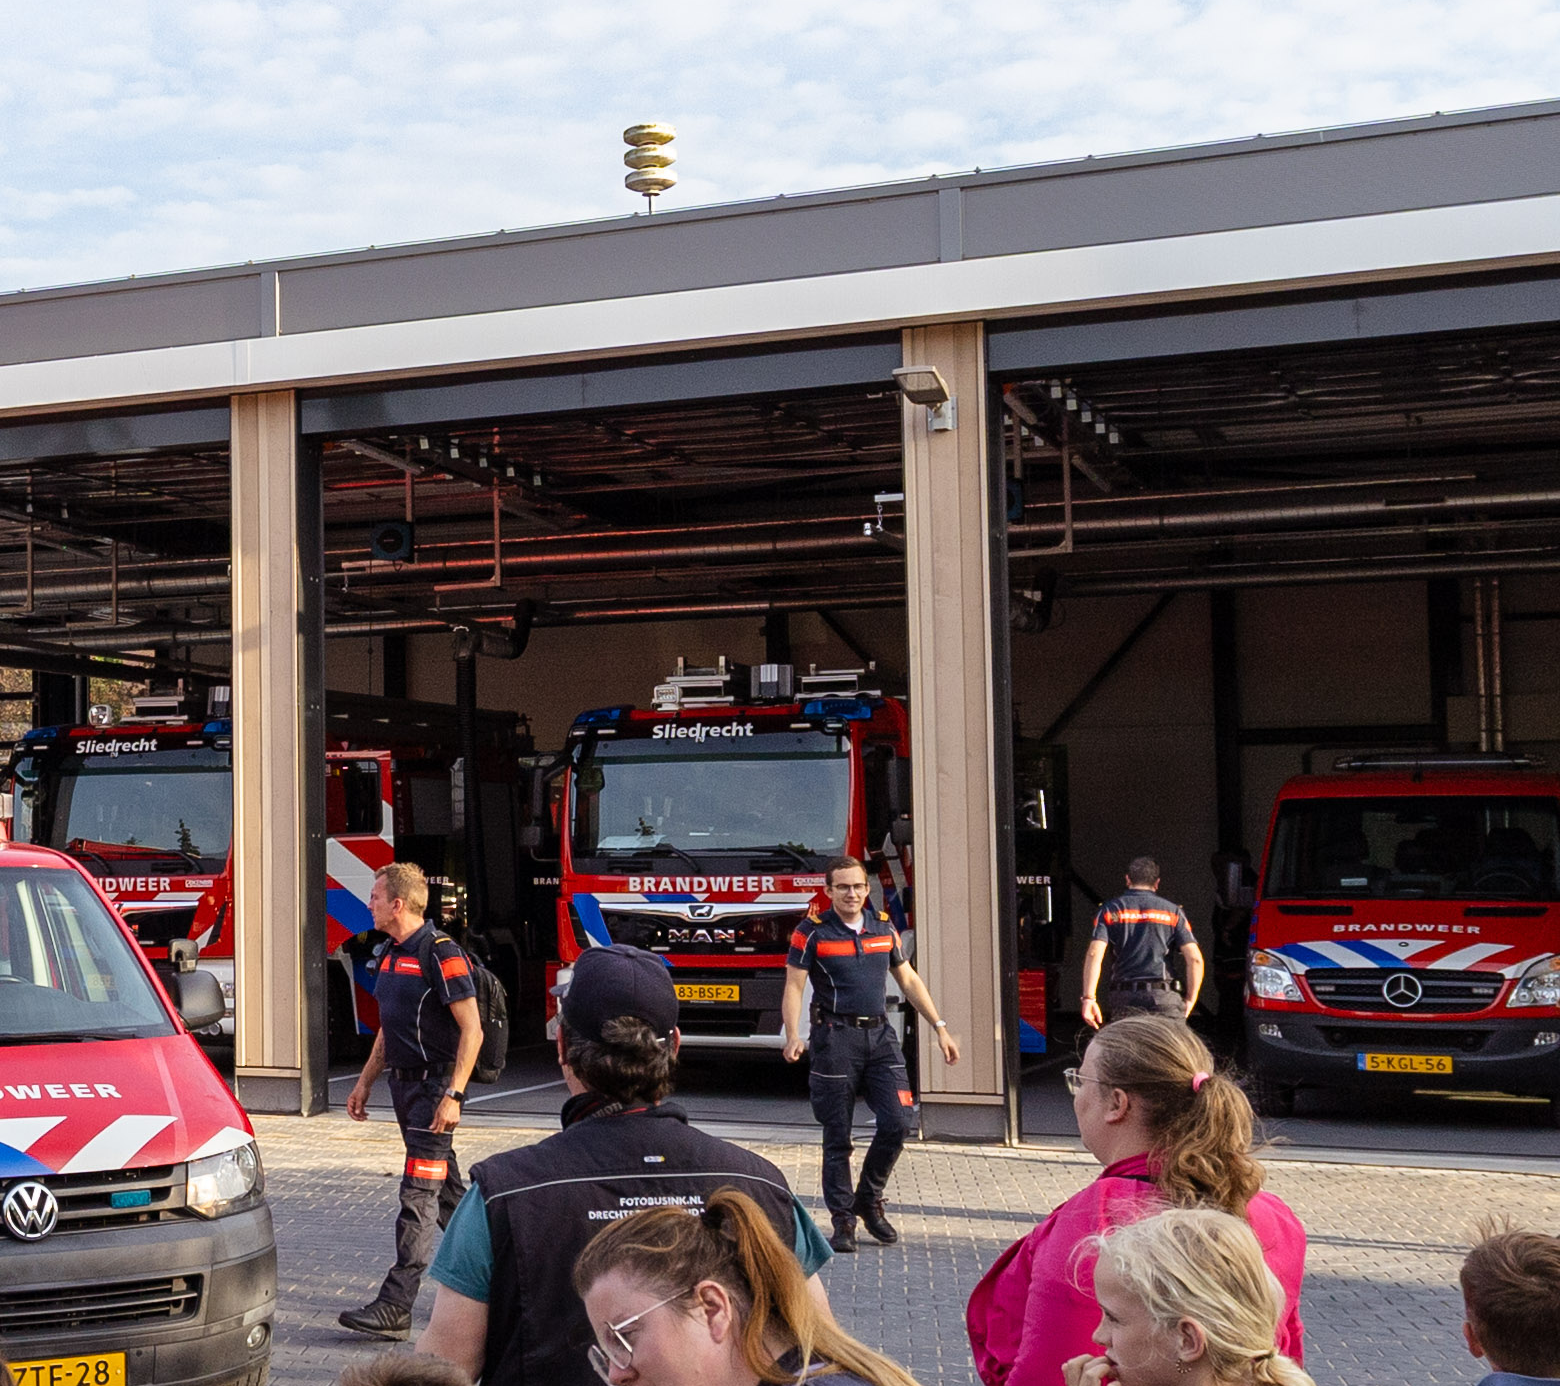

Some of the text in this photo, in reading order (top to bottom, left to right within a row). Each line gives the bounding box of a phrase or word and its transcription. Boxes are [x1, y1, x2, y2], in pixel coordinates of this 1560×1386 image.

[652, 722, 754, 739] Sliedrecht
[76, 738, 158, 754] Sliedrecht
[533, 877, 560, 885] BRAN
[628, 876, 775, 892] BRANDWEER
[1016, 876, 1051, 884] WEER
[668, 928, 736, 943] MAN
[1333, 923, 1481, 934] BRANDWEER
[678, 986, 735, 999] 83-BSF-2
[1370, 1056, 1447, 1071] 5-KGL-56
[620, 1196, 704, 1207] FOTOBUSINK.NL
